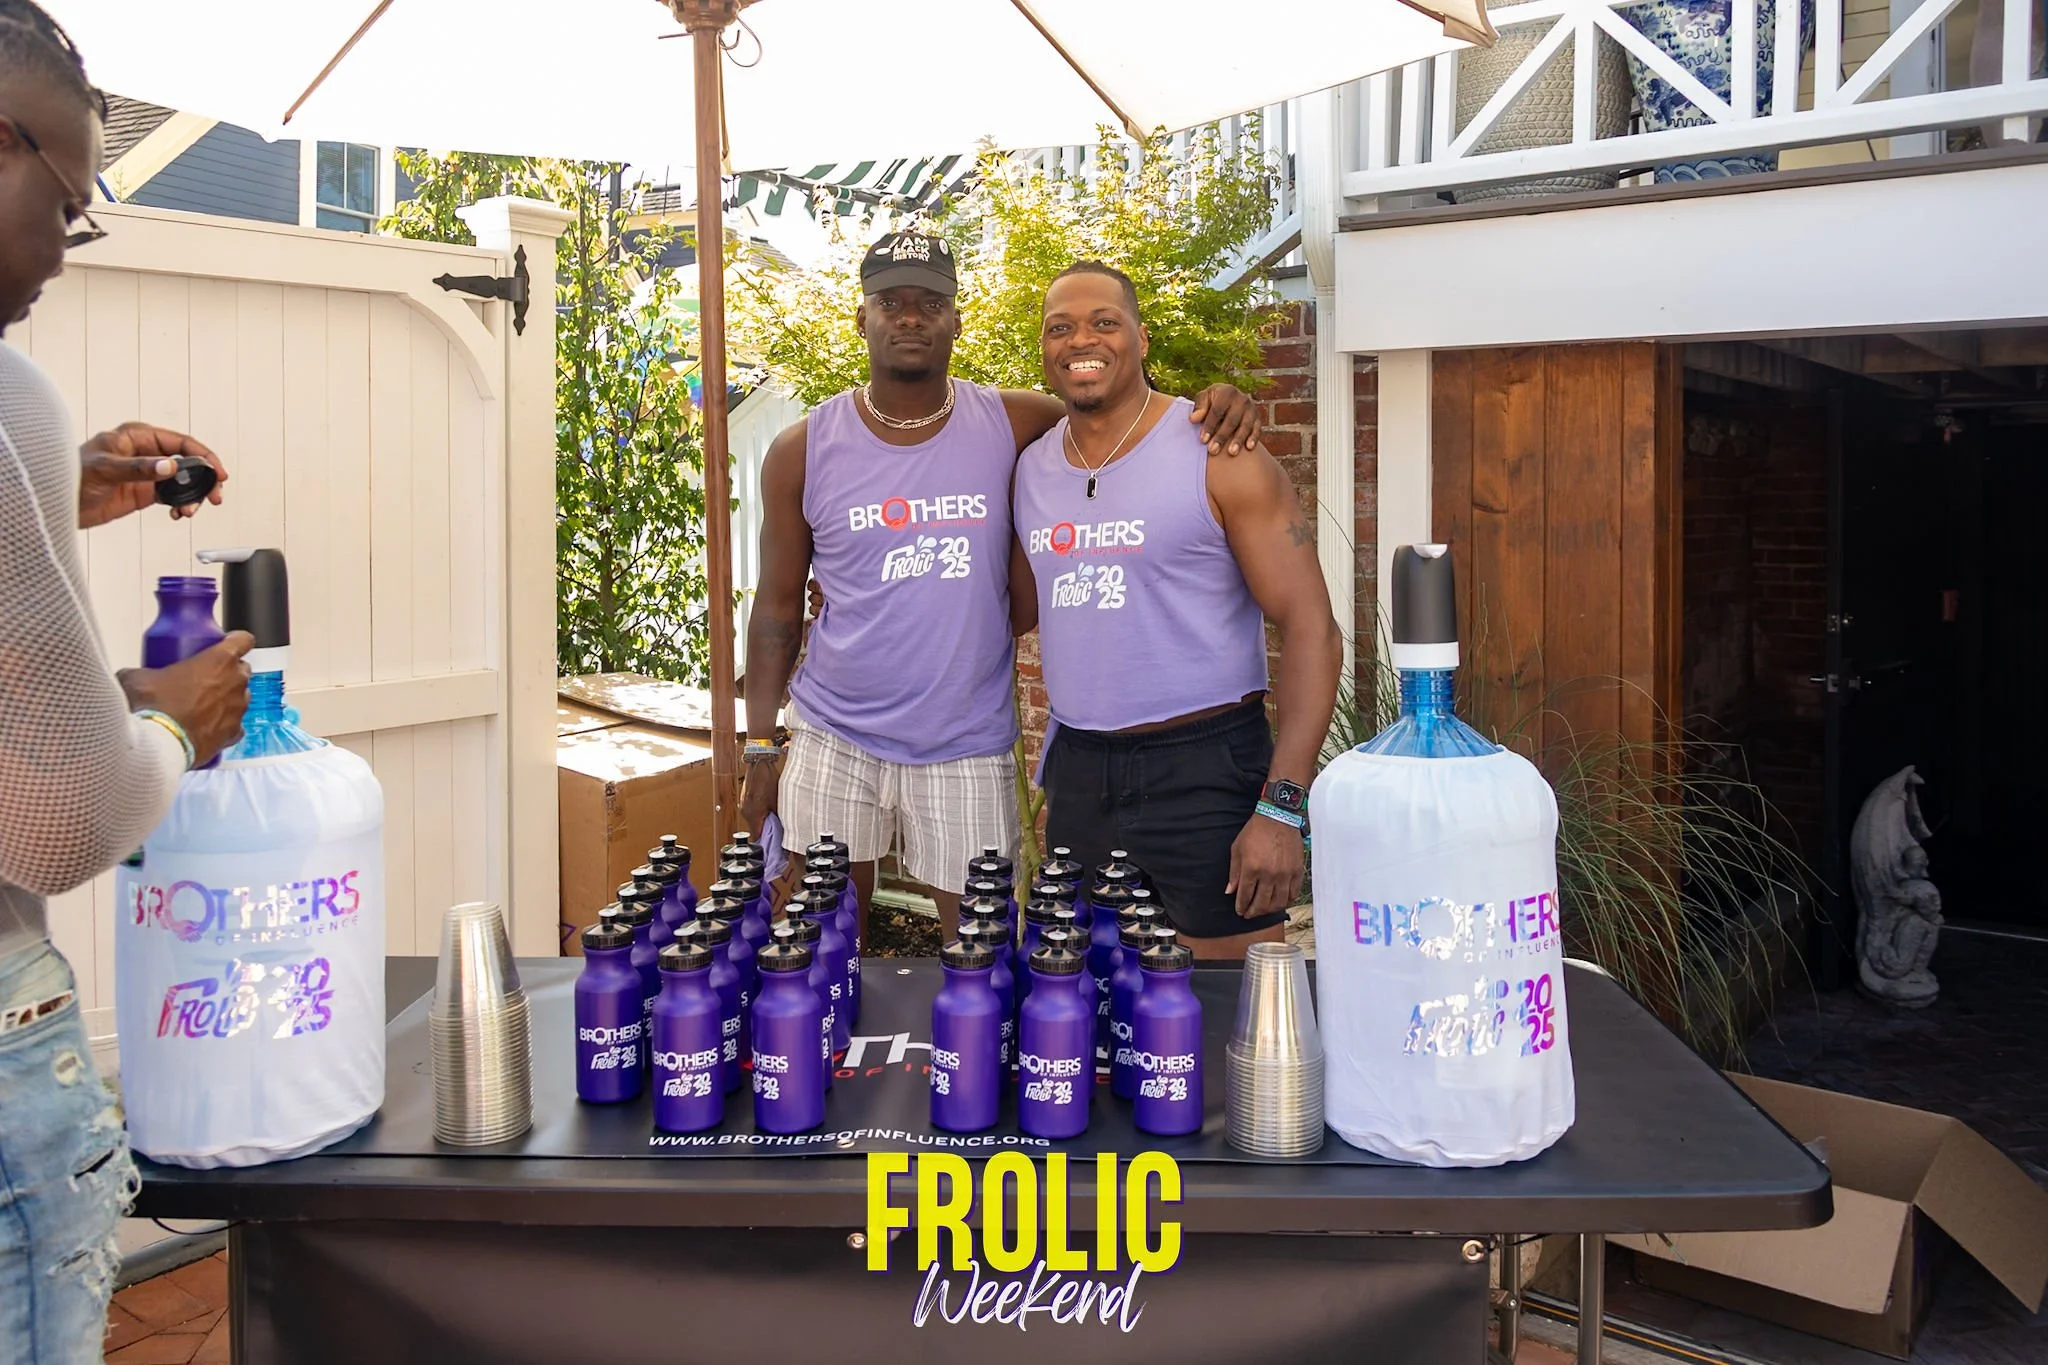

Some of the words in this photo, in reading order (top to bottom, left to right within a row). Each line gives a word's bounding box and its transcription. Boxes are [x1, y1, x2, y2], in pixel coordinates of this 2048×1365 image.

[849, 494, 987, 531] BROTHERS
[938, 536, 969, 560] 20
[1029, 520, 1145, 556] BROTHERS
[940, 555, 971, 579] 25
[1095, 564, 1124, 588] 20
[1097, 584, 1127, 609] 25
[127, 869, 360, 943] BROTHERS
[1516, 973, 1552, 1020] 20
[580, 1021, 641, 1045] BROTHERS
[1519, 1007, 1555, 1058] 25
[653, 1047, 719, 1071] BROTHERS
[1019, 1051, 1081, 1074] BROTHERS
[1132, 1050, 1195, 1072] BROTHERS
[649, 1128, 1051, 1147] WWW.BROTHERSOFINFLUENCE.ORG
